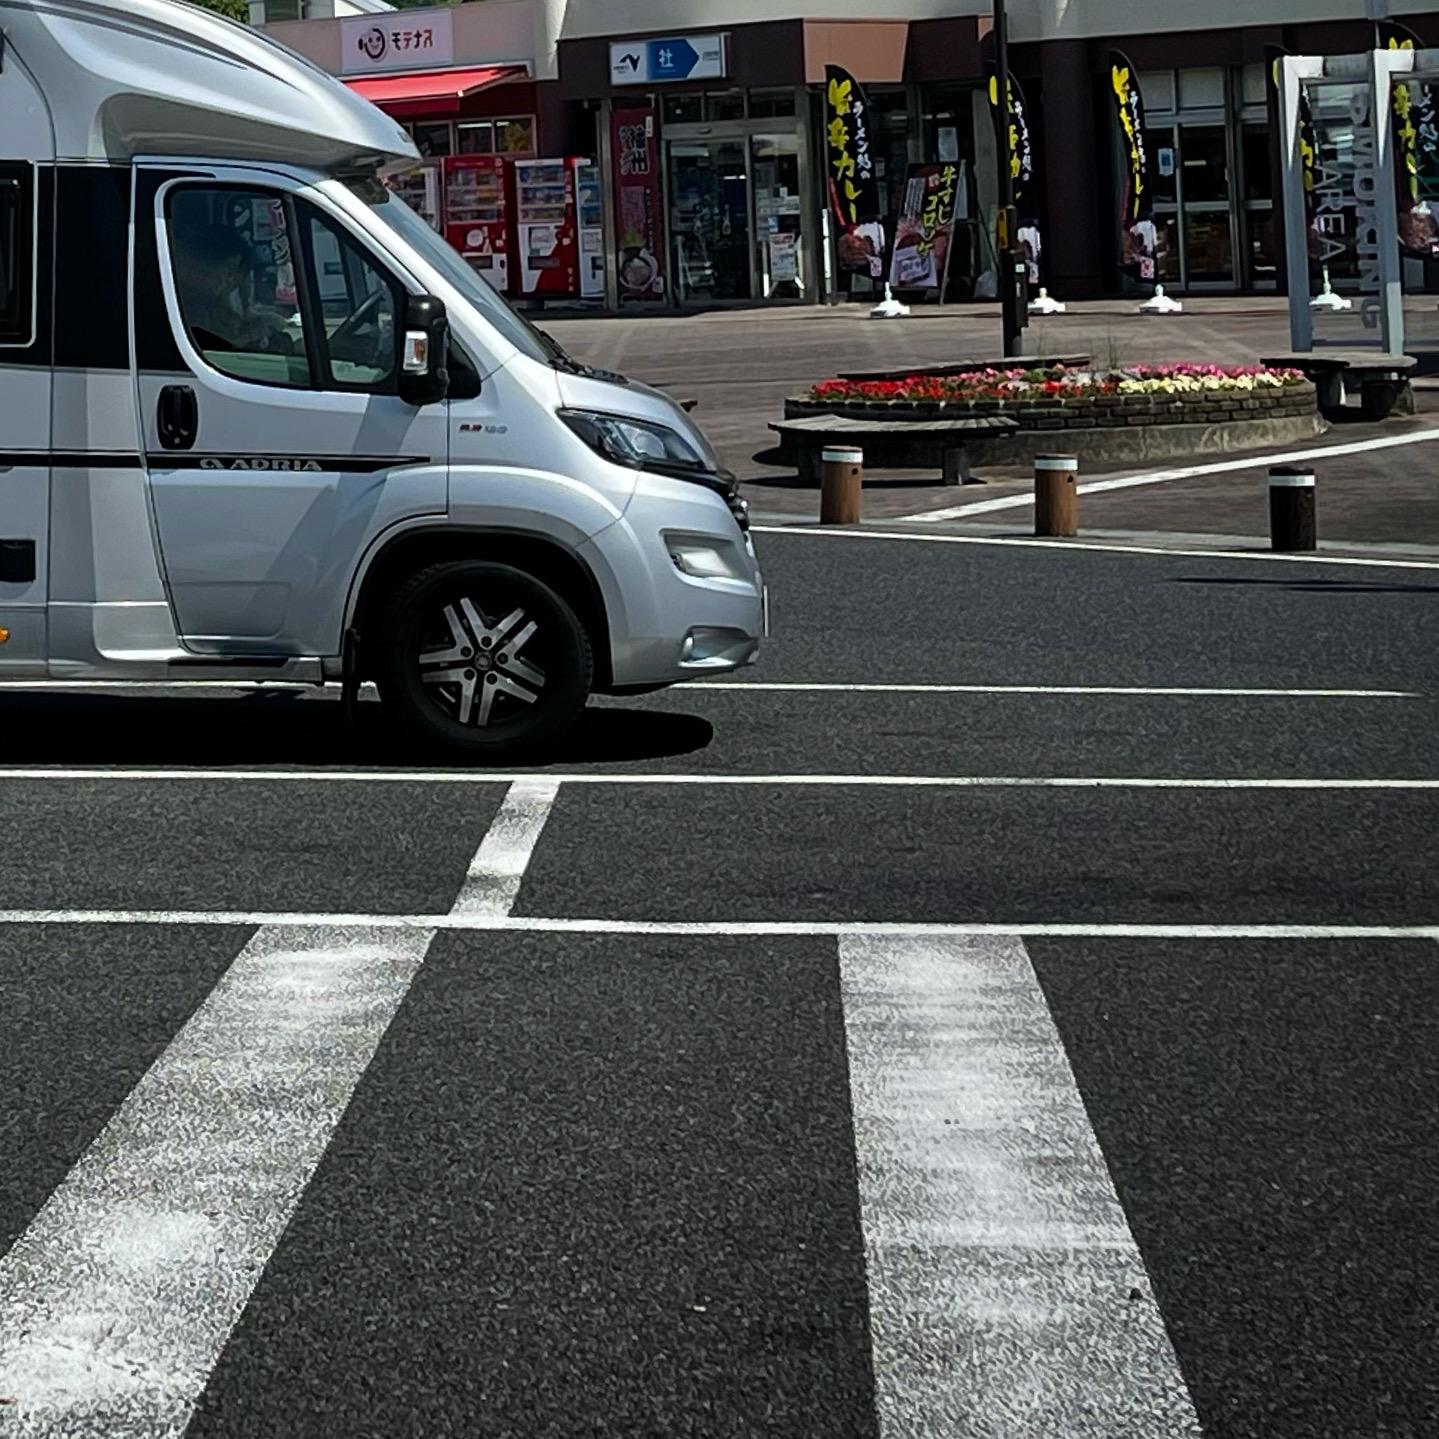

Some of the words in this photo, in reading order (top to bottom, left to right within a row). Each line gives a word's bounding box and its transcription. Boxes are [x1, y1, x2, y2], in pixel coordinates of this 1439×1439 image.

[391, 28, 434, 51] モテナス
[1312, 164, 1347, 262] AREA
[230, 458, 323, 471] ADRIA
